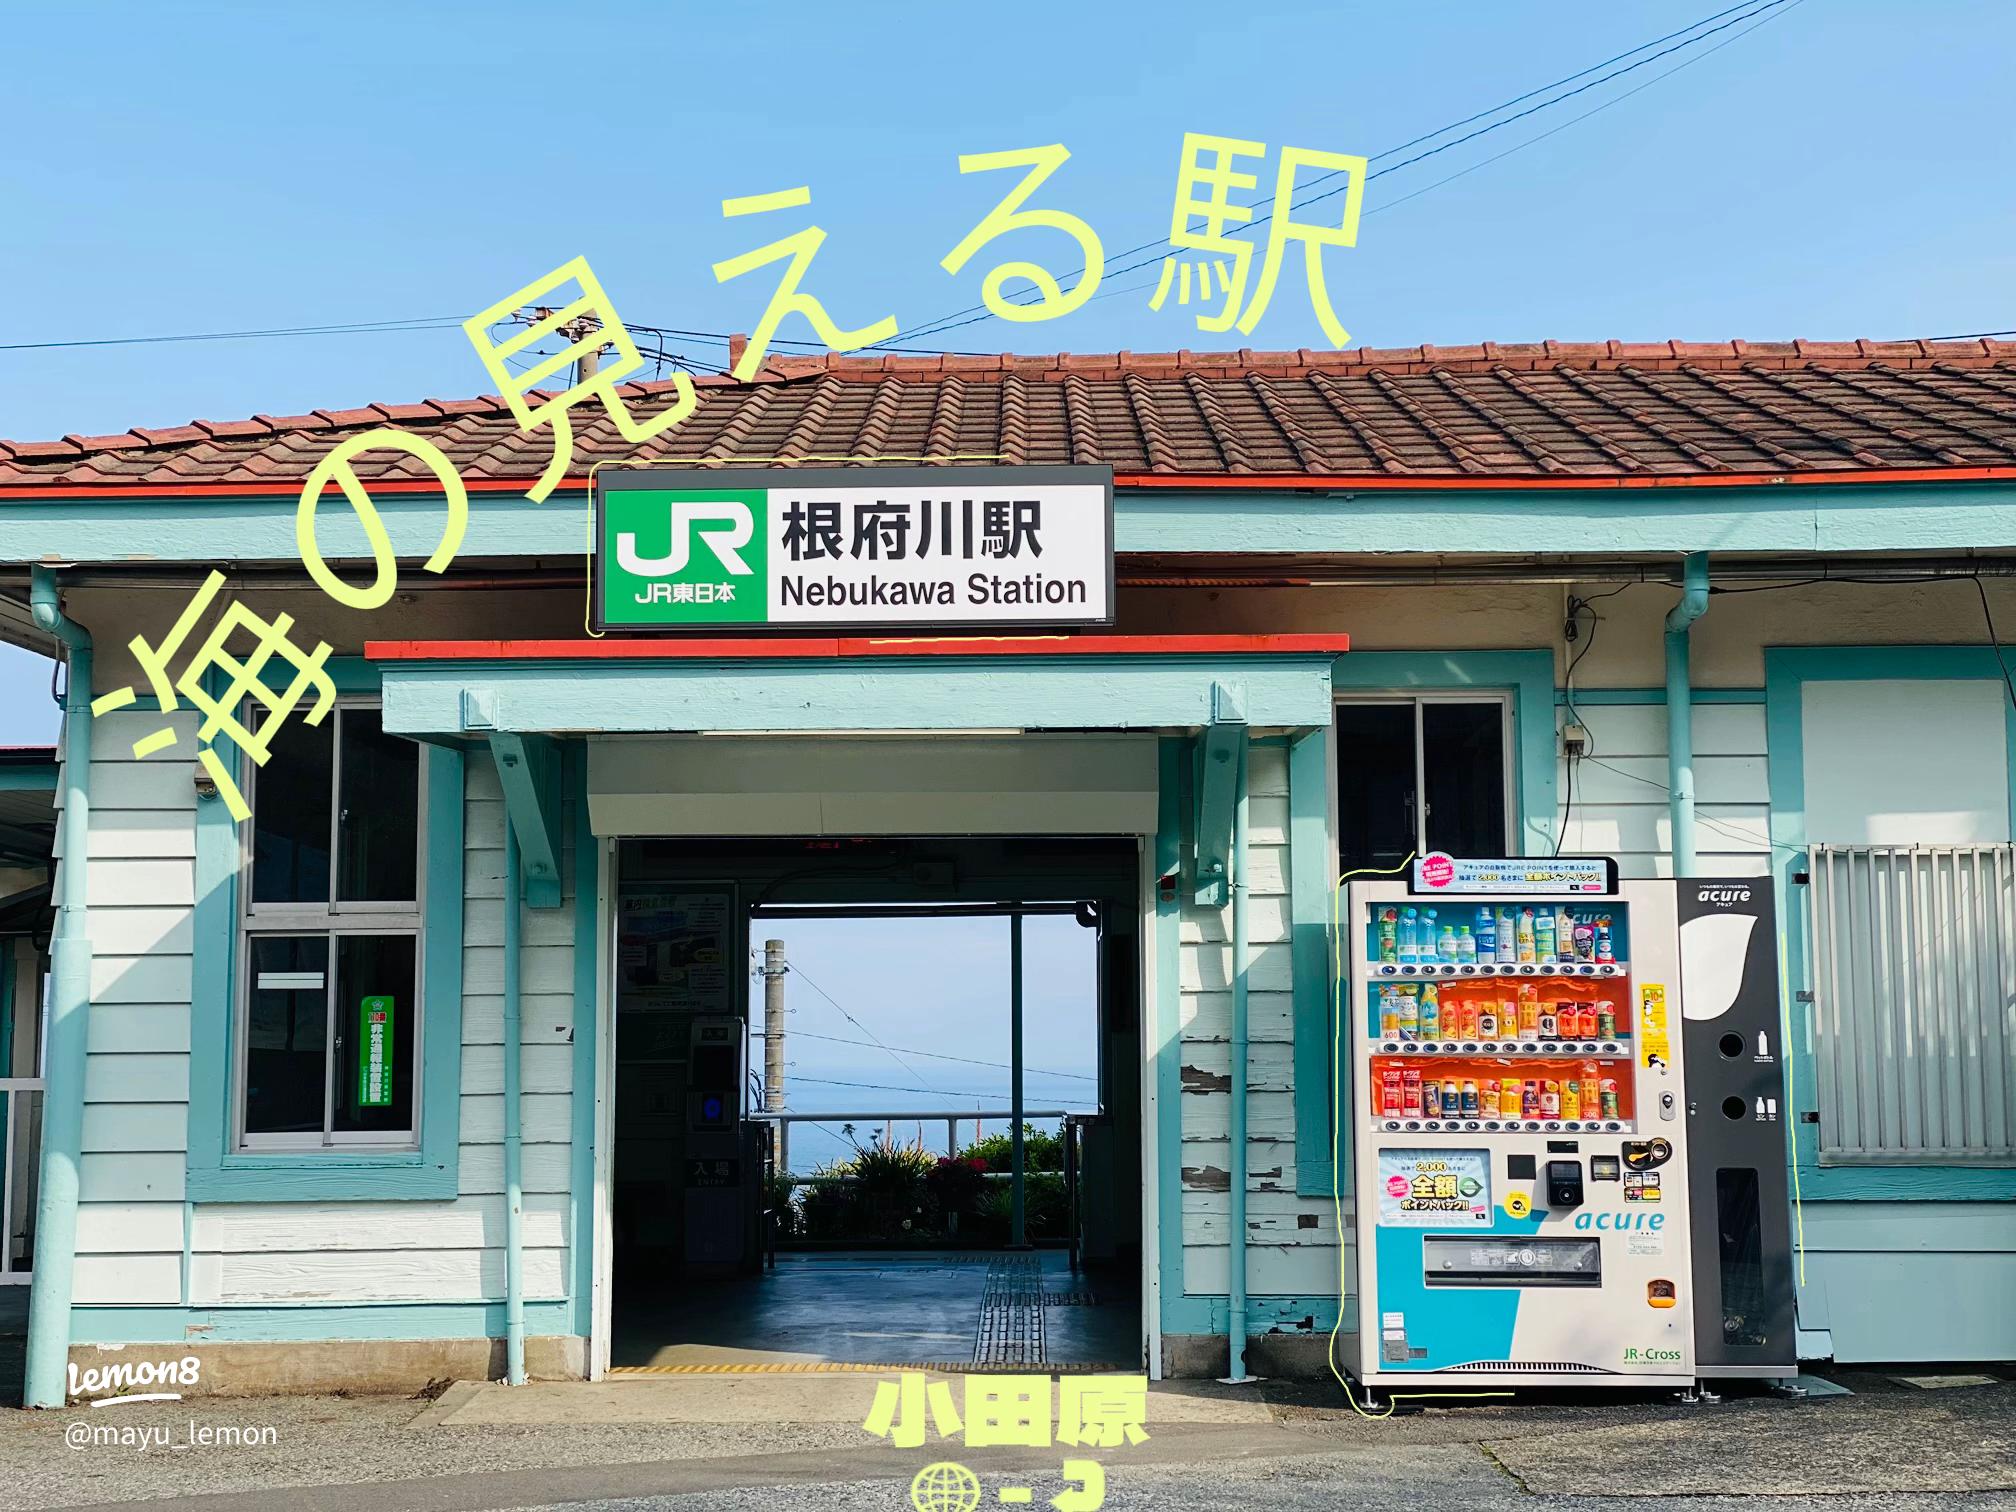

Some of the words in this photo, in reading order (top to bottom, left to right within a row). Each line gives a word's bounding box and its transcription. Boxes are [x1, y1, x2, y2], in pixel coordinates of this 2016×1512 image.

[616, 501, 755, 577] JR
[781, 499, 1043, 561] 根府川駅
[635, 581, 736, 604] JR東日本
[781, 575, 955, 606] Nebukawa
[967, 573, 1086, 605] Station
[1698, 890, 1751, 902] acure
[1411, 1174, 1458, 1200] 全額
[1574, 1211, 1665, 1231] acure
